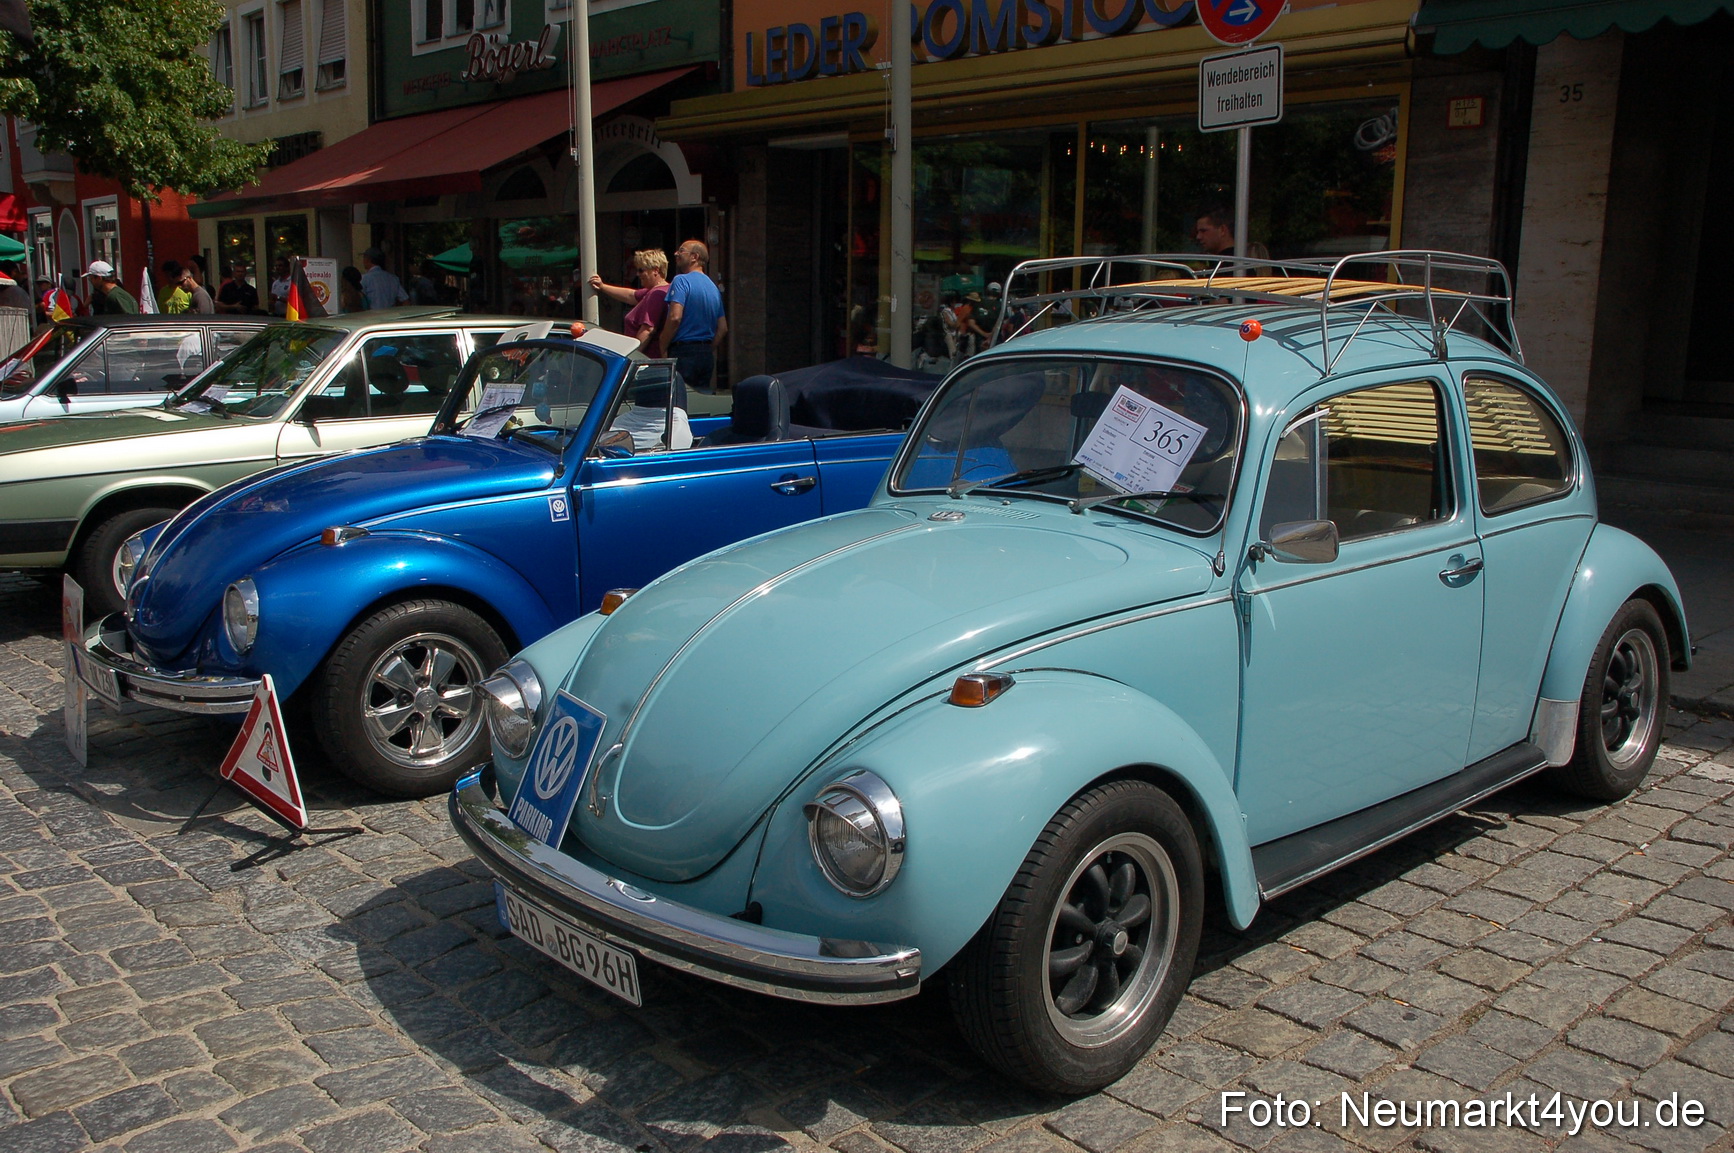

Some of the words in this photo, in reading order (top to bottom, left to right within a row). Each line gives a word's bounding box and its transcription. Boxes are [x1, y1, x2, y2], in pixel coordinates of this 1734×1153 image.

[460, 24, 556, 83] Bögerl
[746, 11, 874, 86] LEDER
[1206, 60, 1275, 88] Wendebereich
[1559, 83, 1583, 103] 35
[1217, 92, 1263, 112] freihalten
[1143, 420, 1190, 455] 365
[513, 796, 553, 844] PARKING
[506, 895, 544, 947] SAD
[554, 924, 635, 997] BG96H
